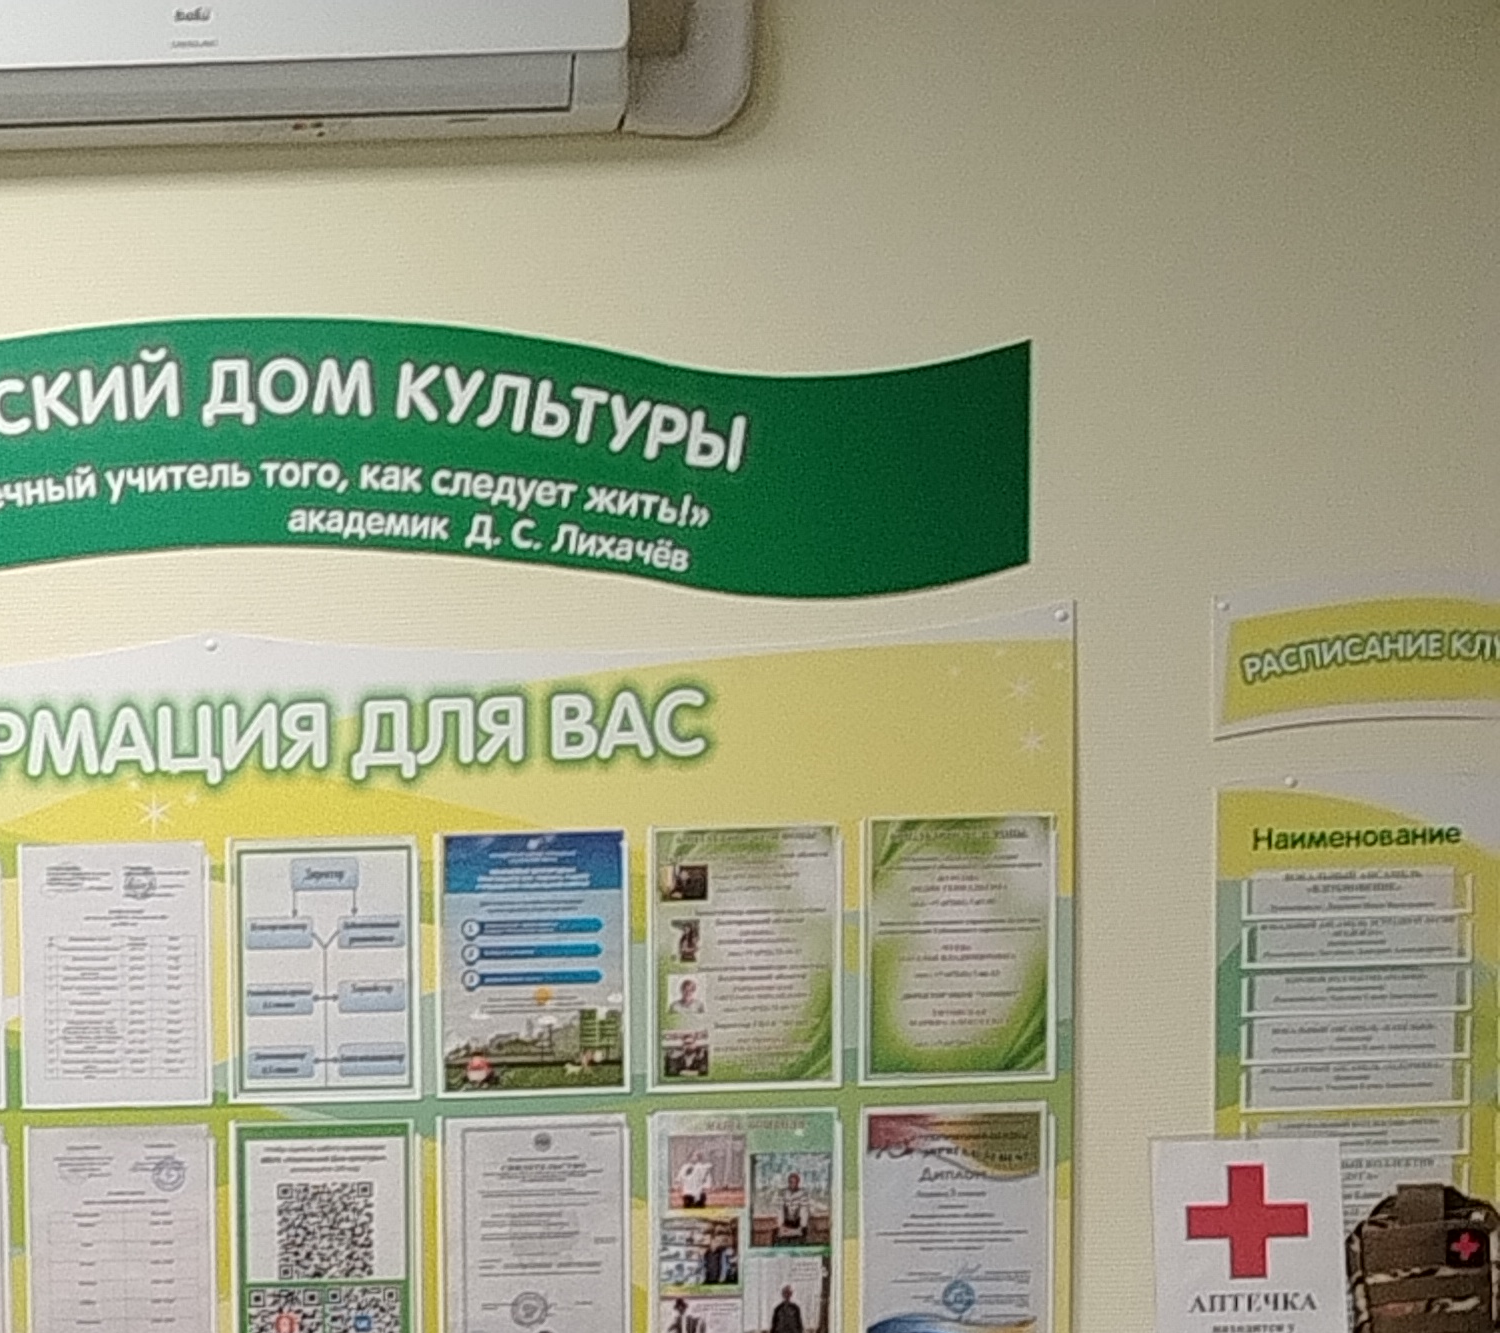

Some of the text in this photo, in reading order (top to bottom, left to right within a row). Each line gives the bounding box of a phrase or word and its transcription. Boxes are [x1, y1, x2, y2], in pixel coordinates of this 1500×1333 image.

[202, 357, 374, 427] ДОМ
[398, 362, 748, 472] КУЛЬТУРЫ
[105, 460, 251, 504] учитель
[260, 459, 350, 495] того,
[359, 463, 422, 493] как
[431, 471, 577, 512] следует
[586, 486, 710, 529] жить!»
[287, 506, 690, 573] академик Д. С. Лихачёв
[1243, 631, 1443, 684] РАСПИСАНИЕ
[351, 695, 524, 780] ДЛЯ
[550, 687, 708, 760] ВАС
[1252, 826, 1463, 851] Наименование
[1188, 1292, 1318, 1313] АПТЕЧКА
